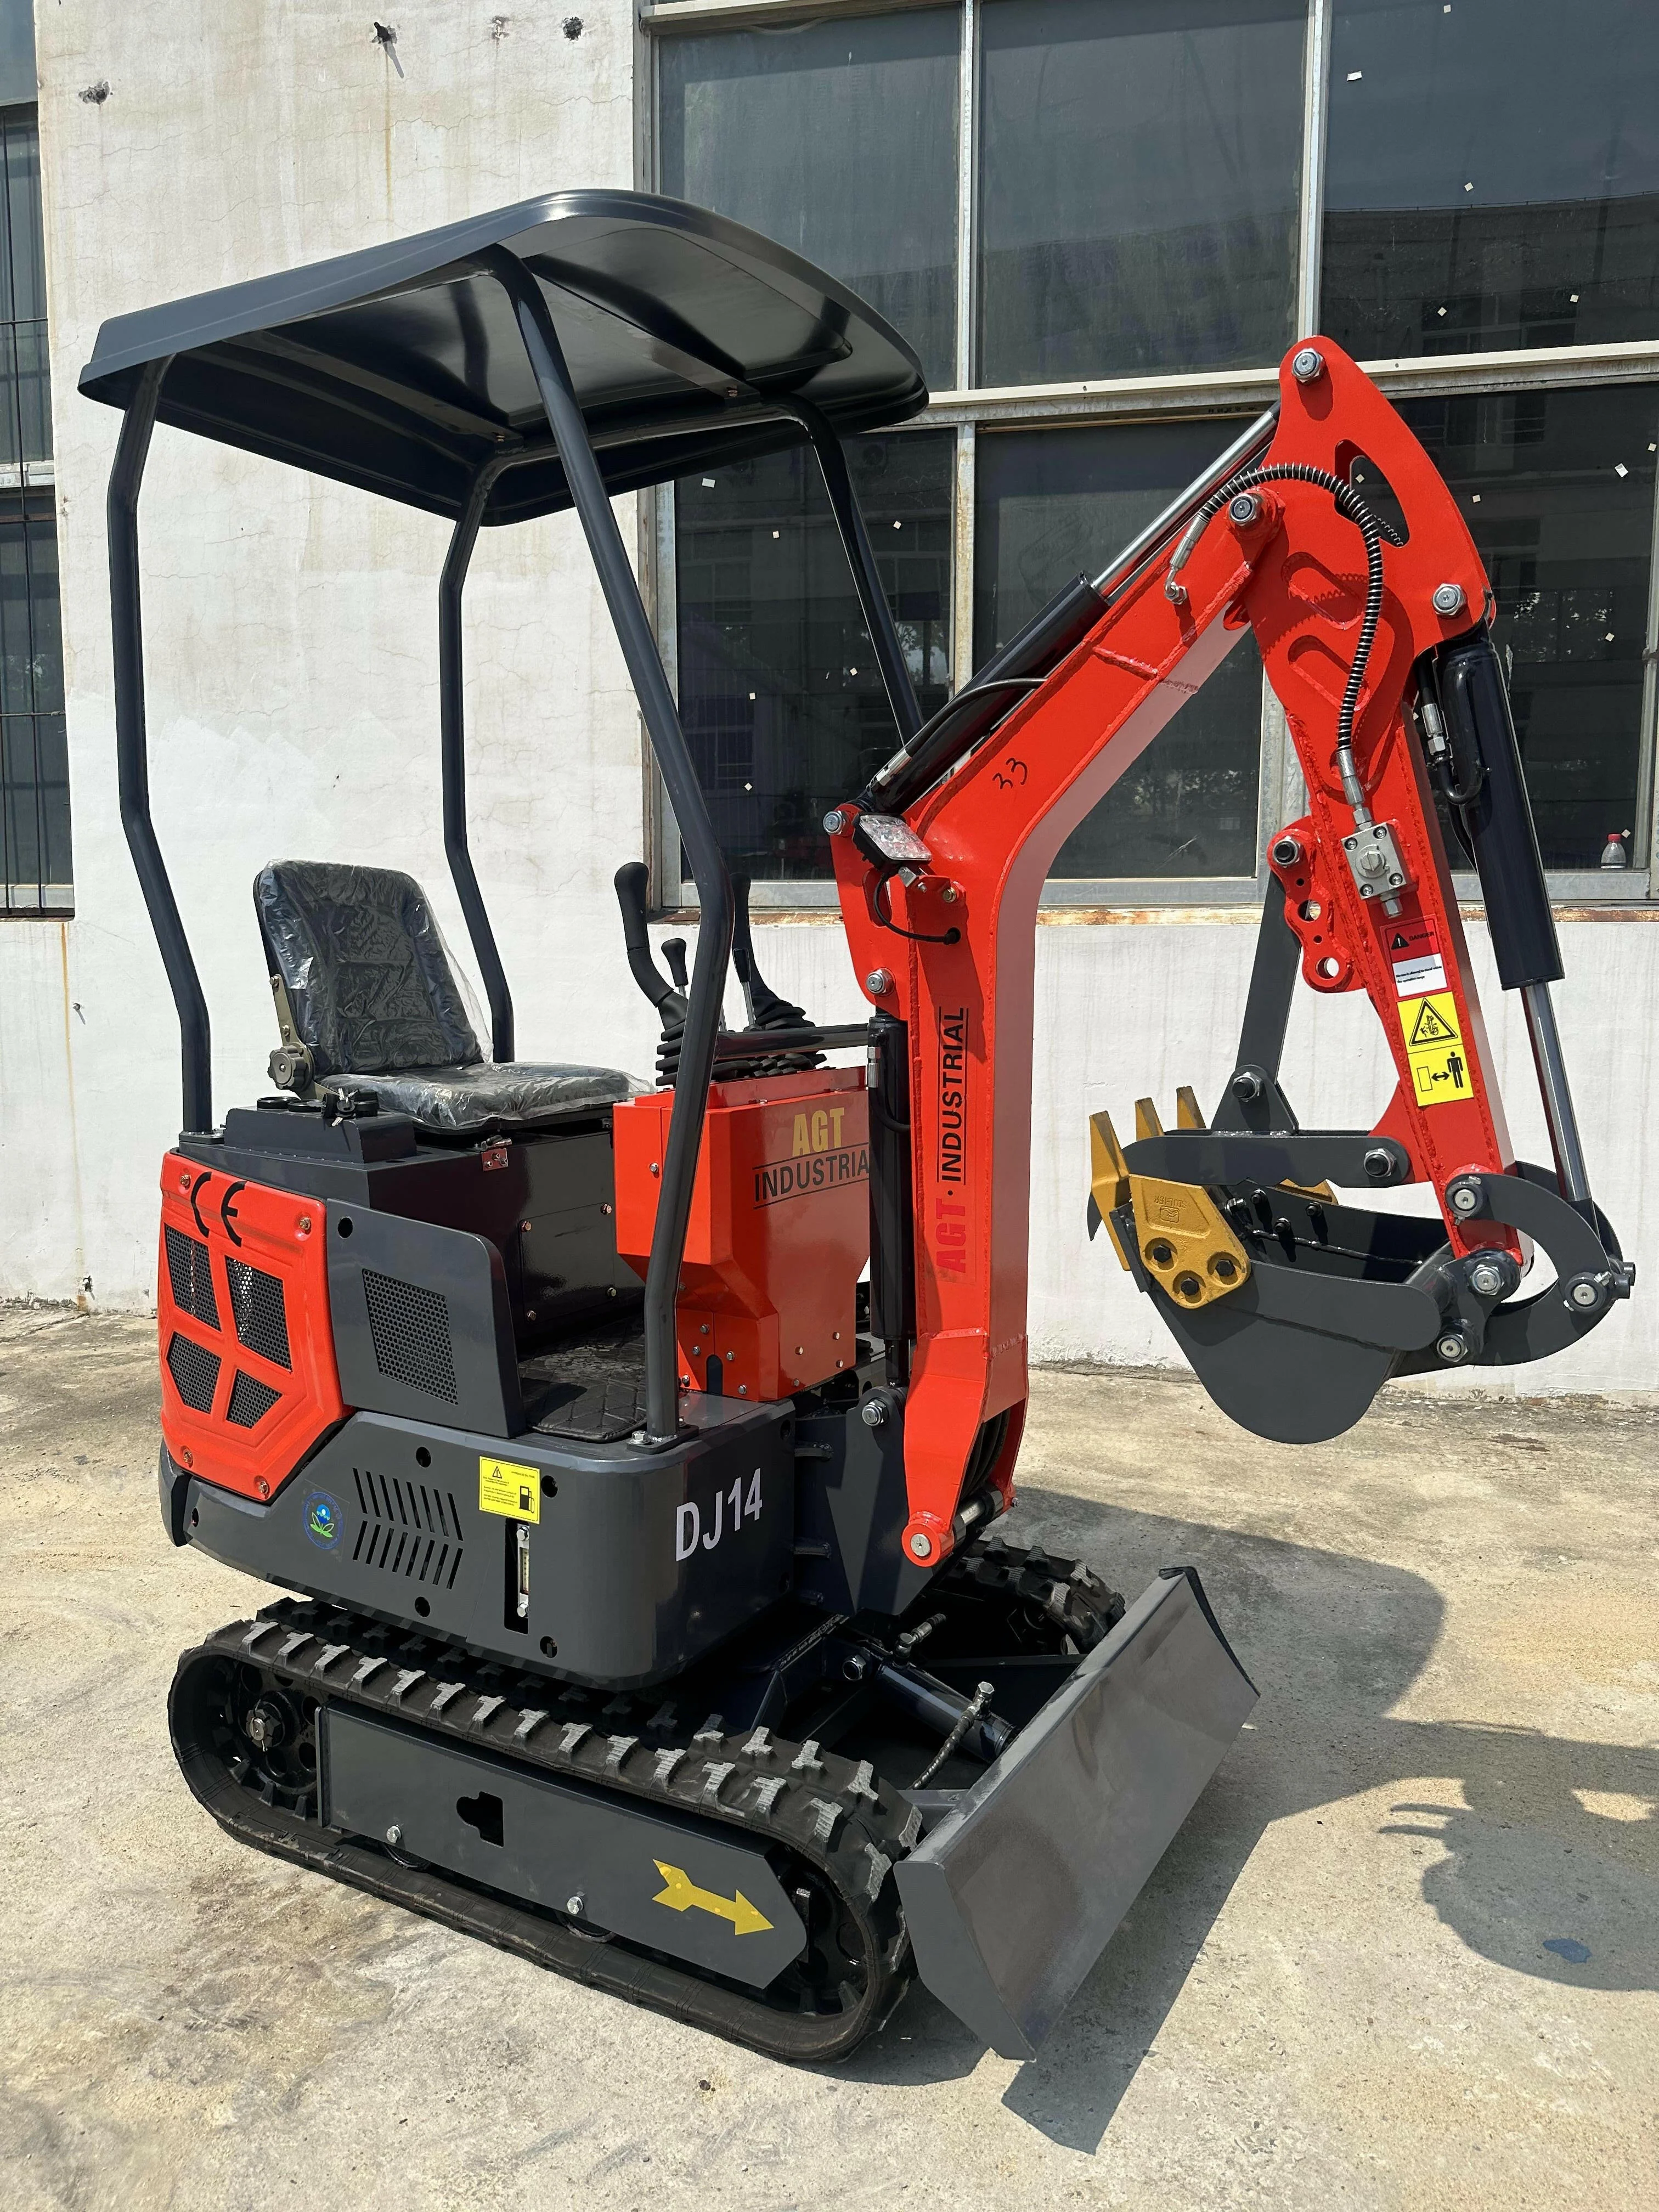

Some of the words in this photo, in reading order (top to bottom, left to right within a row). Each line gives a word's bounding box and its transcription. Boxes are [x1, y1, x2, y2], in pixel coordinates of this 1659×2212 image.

[992, 758, 1028, 790] 33
[792, 1107, 845, 1157] AGT
[942, 1008, 964, 1182] INDUSTRIAL
[190, 1171, 247, 1248] CE
[754, 1152, 870, 1202] INDUSTRIA
[935, 1198, 967, 1273] AGT
[676, 1468, 763, 1562] DJ14
